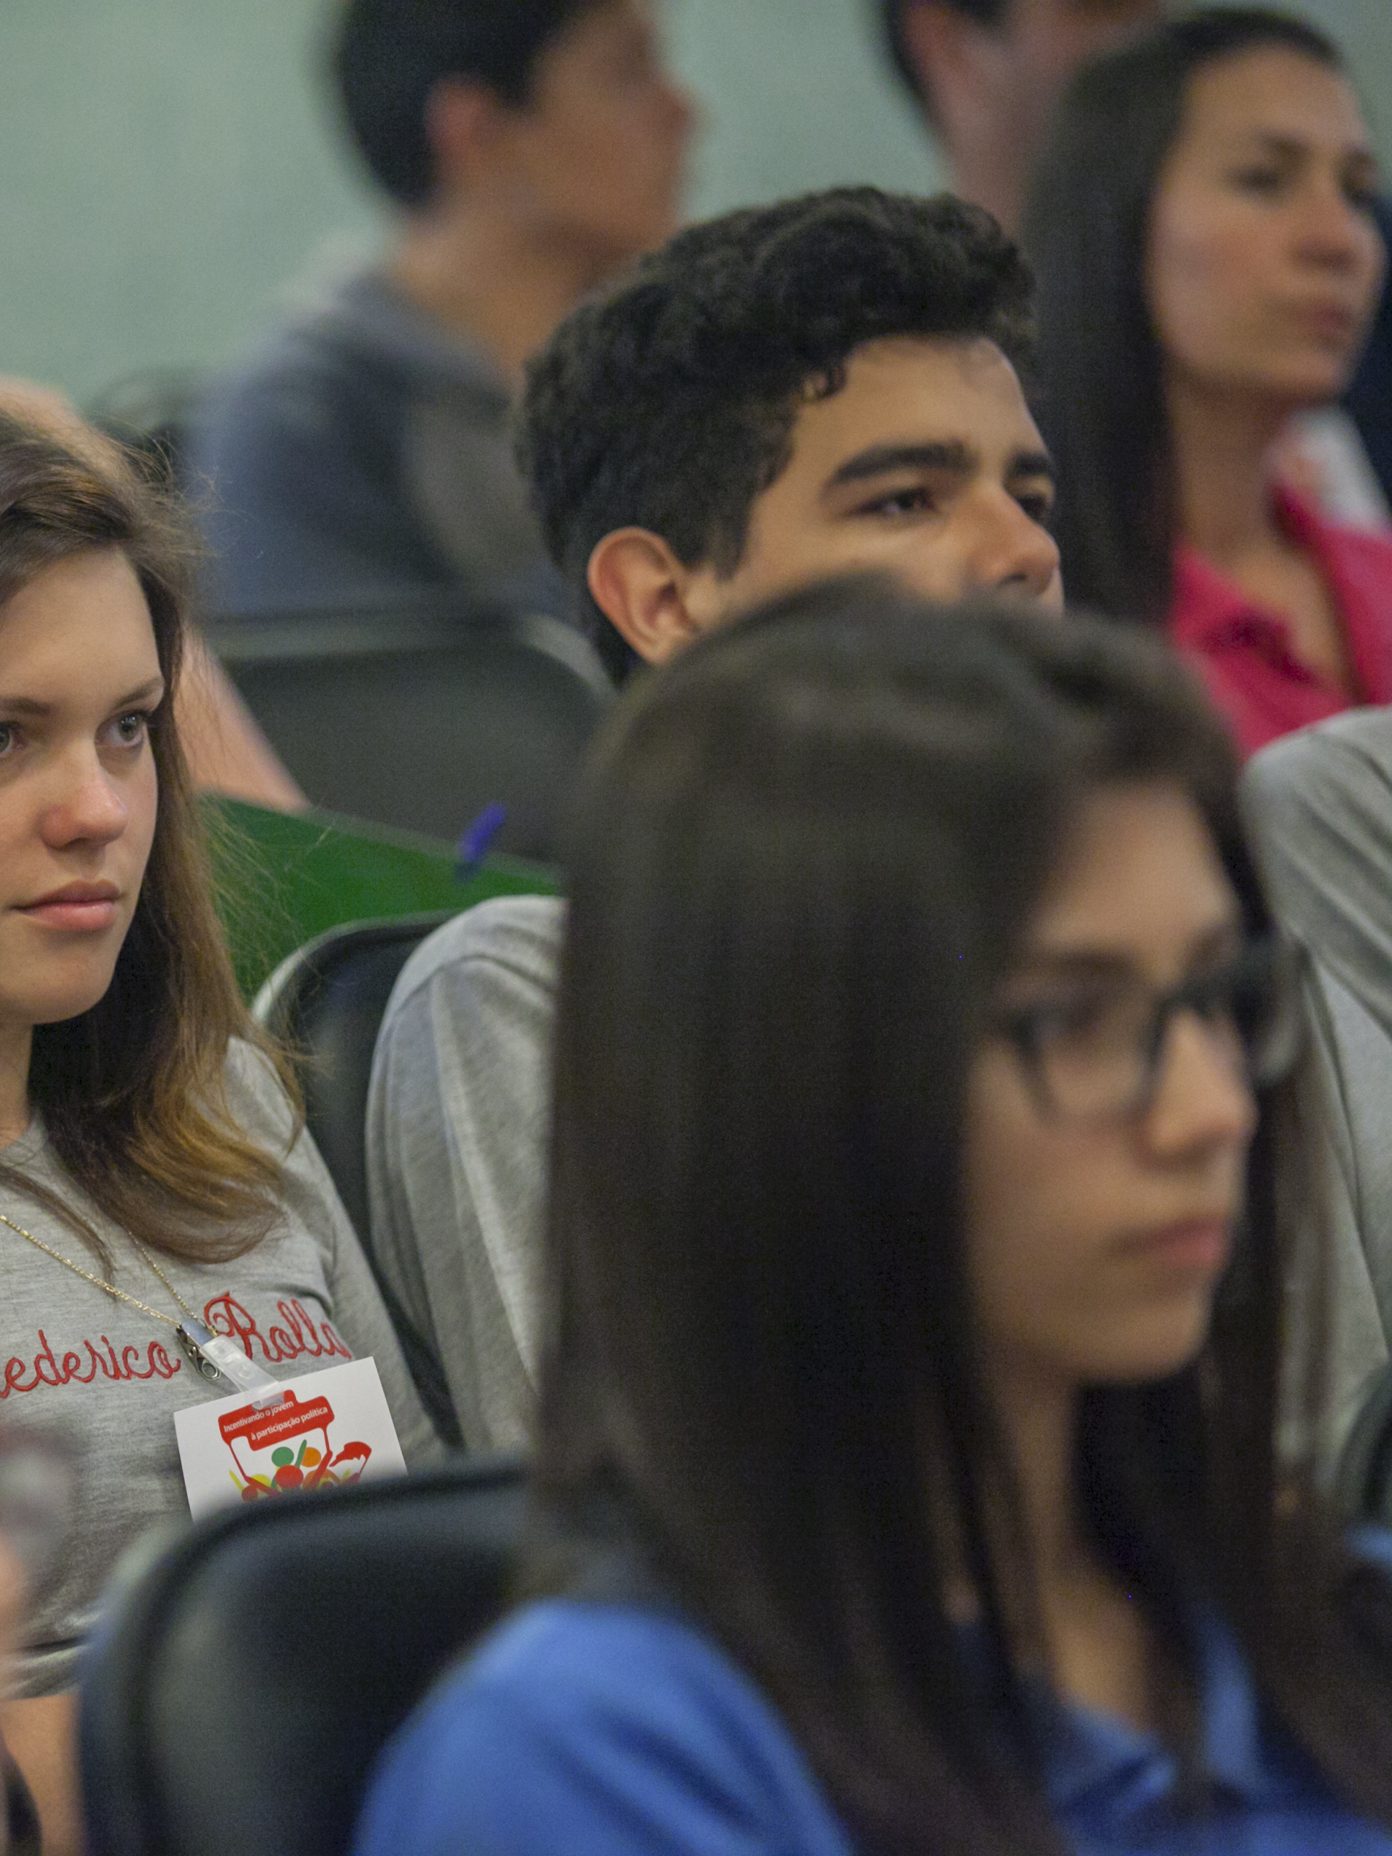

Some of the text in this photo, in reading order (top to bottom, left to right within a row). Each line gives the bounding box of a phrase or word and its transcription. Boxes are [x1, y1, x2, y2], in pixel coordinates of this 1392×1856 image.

[223, 1411, 265, 1432] Incentivando
[271, 1401, 294, 1416] jovem
[256, 1417, 300, 1440] participação
[301, 1406, 328, 1422] política
